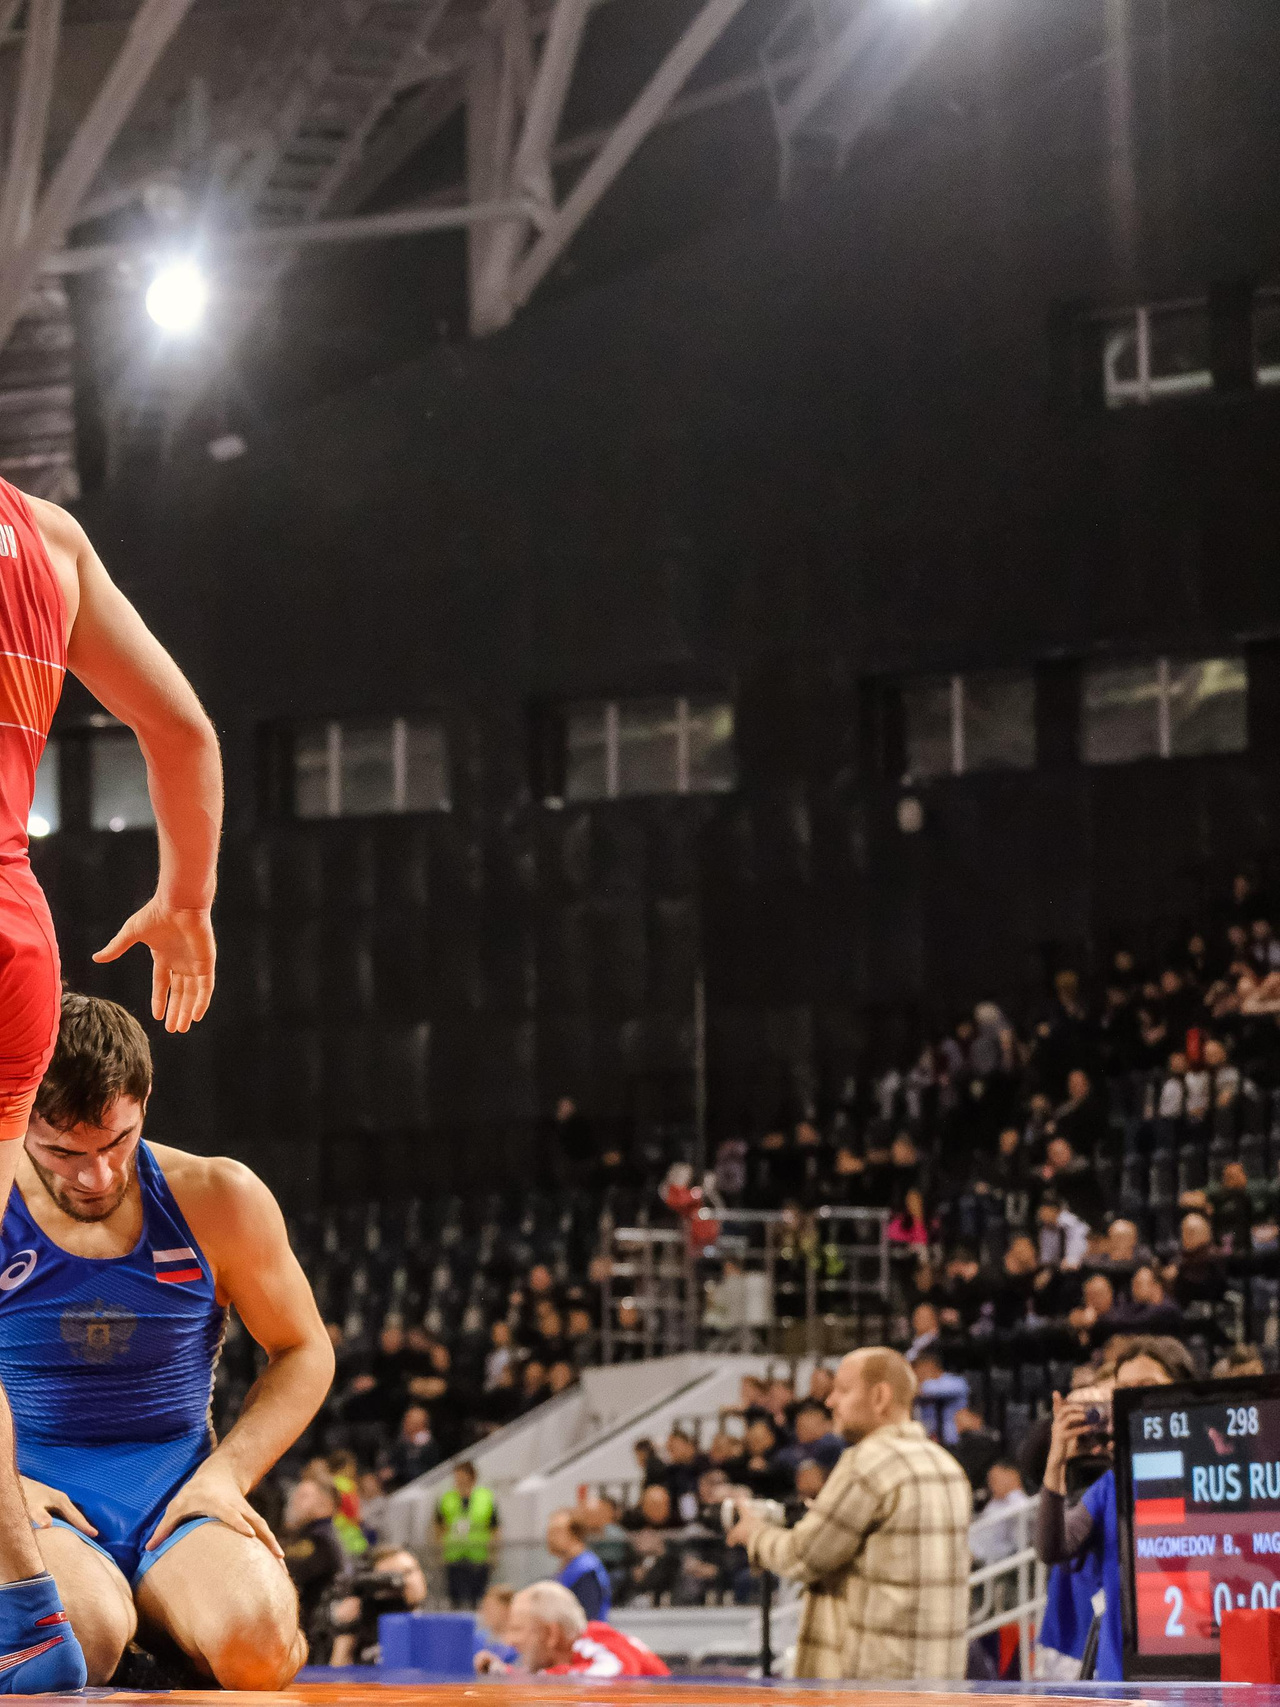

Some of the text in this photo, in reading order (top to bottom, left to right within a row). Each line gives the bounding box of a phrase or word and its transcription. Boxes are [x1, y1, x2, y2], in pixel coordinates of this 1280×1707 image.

[1143, 1405, 1260, 1440] FS 61 298
[1192, 1462, 1242, 1503] RUS
[1136, 1534, 1216, 1558] MAGOMEDOV
[1223, 1533, 1241, 1556] B.
[1164, 1585, 1185, 1637] 2
